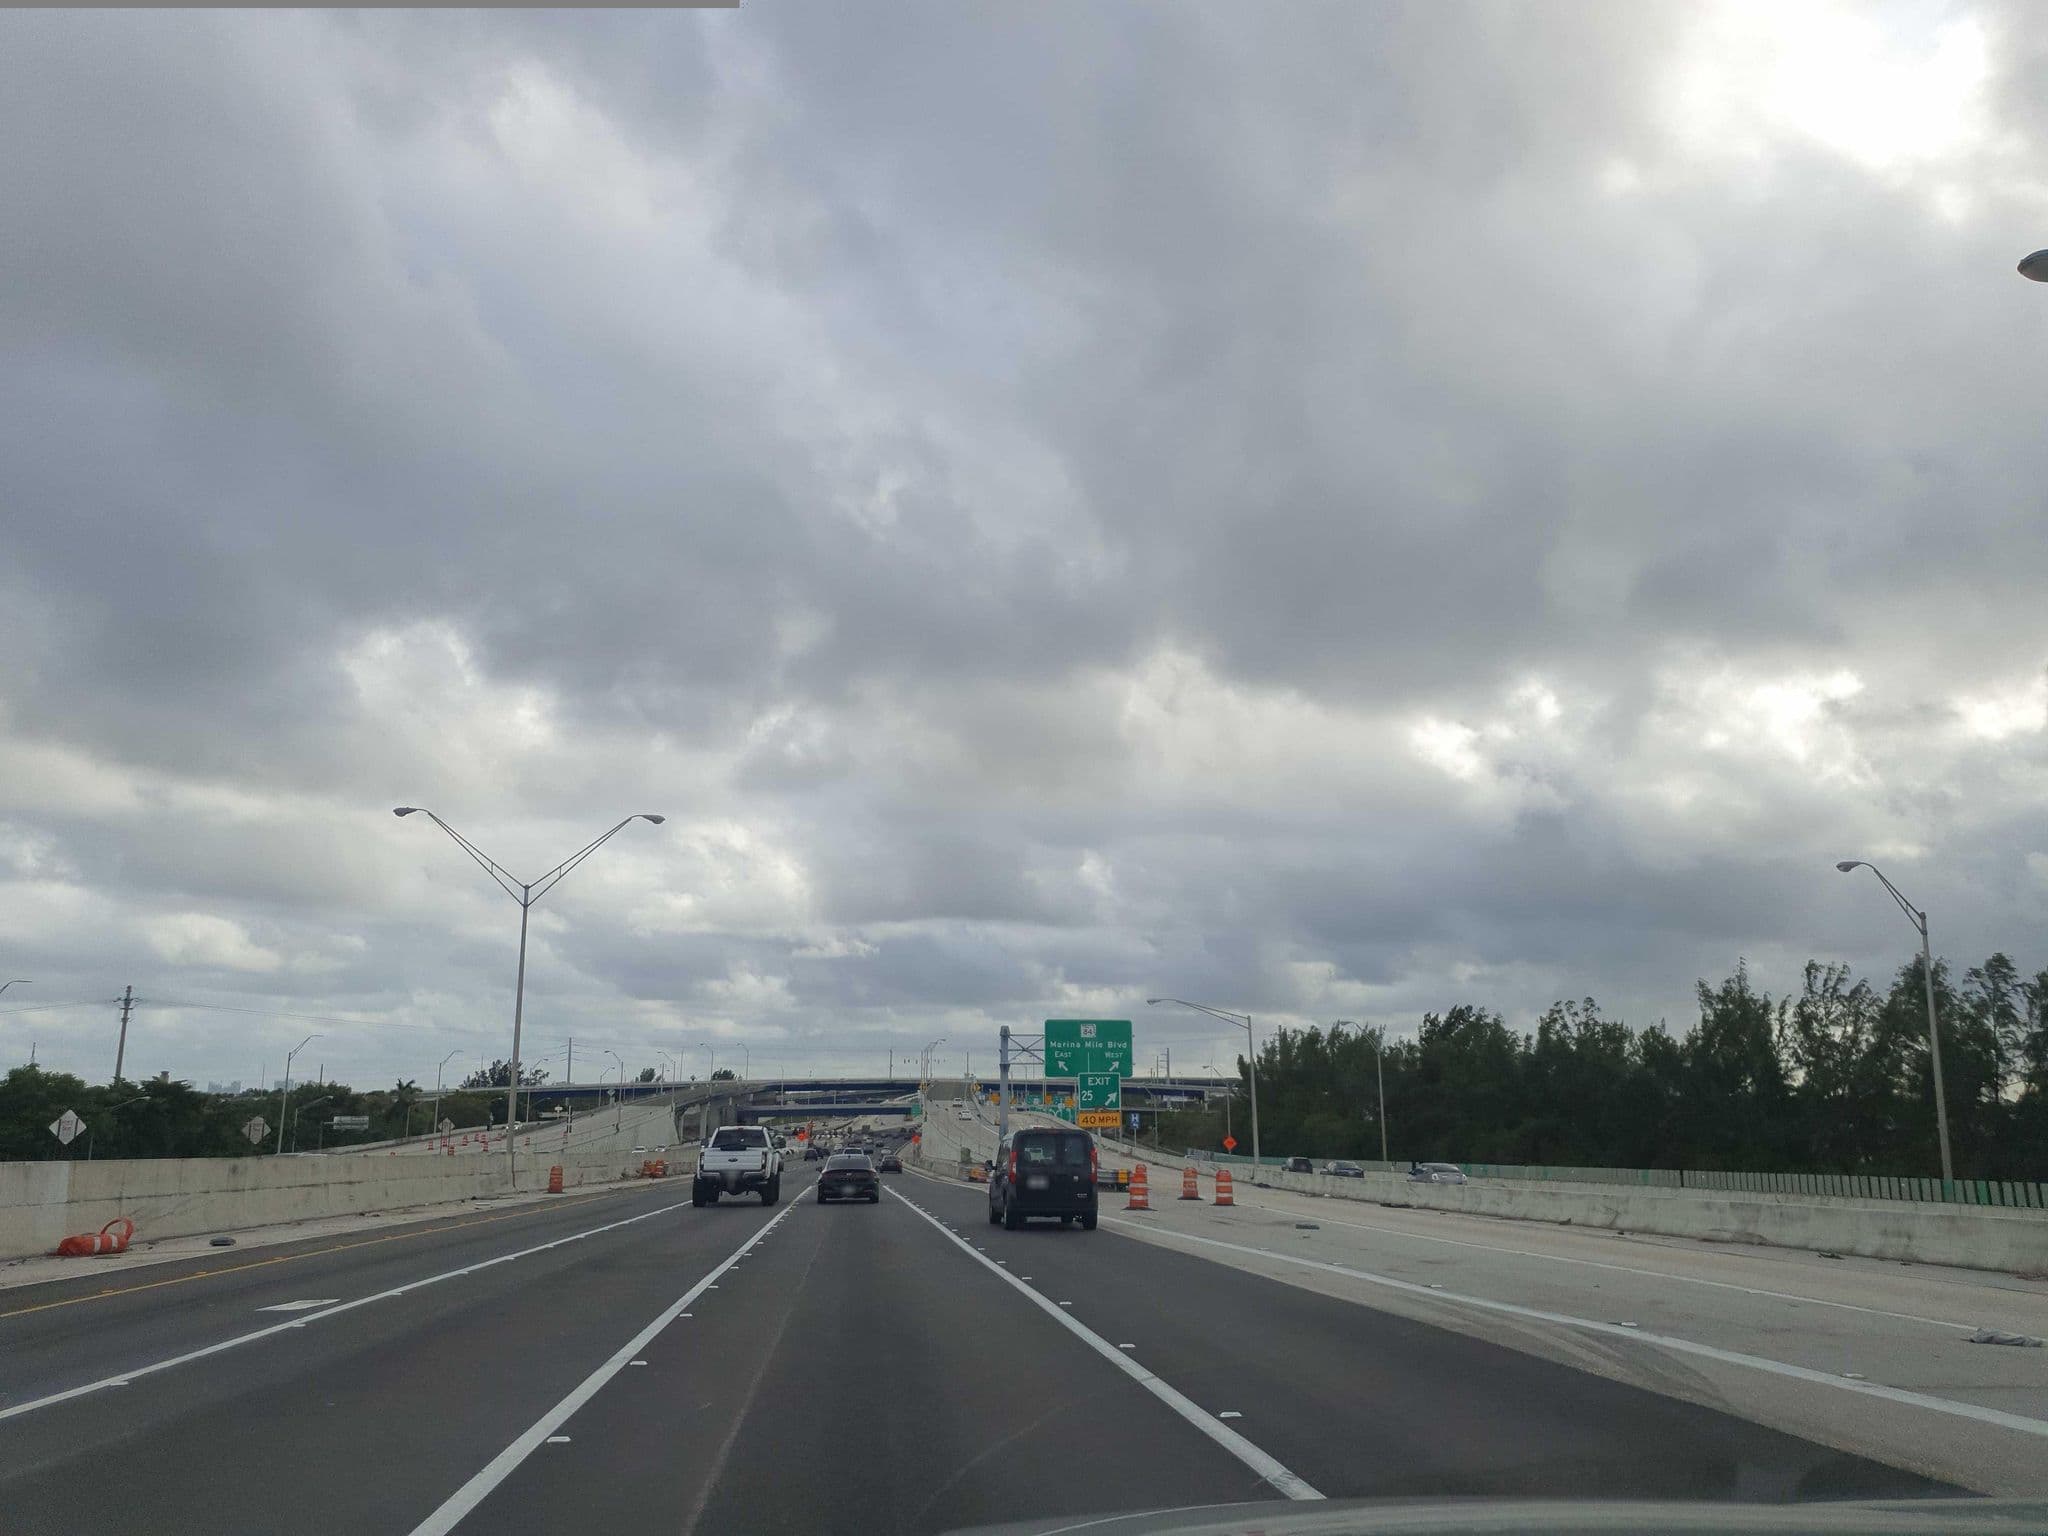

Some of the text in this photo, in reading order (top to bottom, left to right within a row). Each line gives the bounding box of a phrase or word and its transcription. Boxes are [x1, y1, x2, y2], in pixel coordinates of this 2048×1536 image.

[1088, 1077, 1110, 1086] EXIT
[1082, 1090, 1093, 1100] 25
[1082, 1116, 1096, 1124] 40
